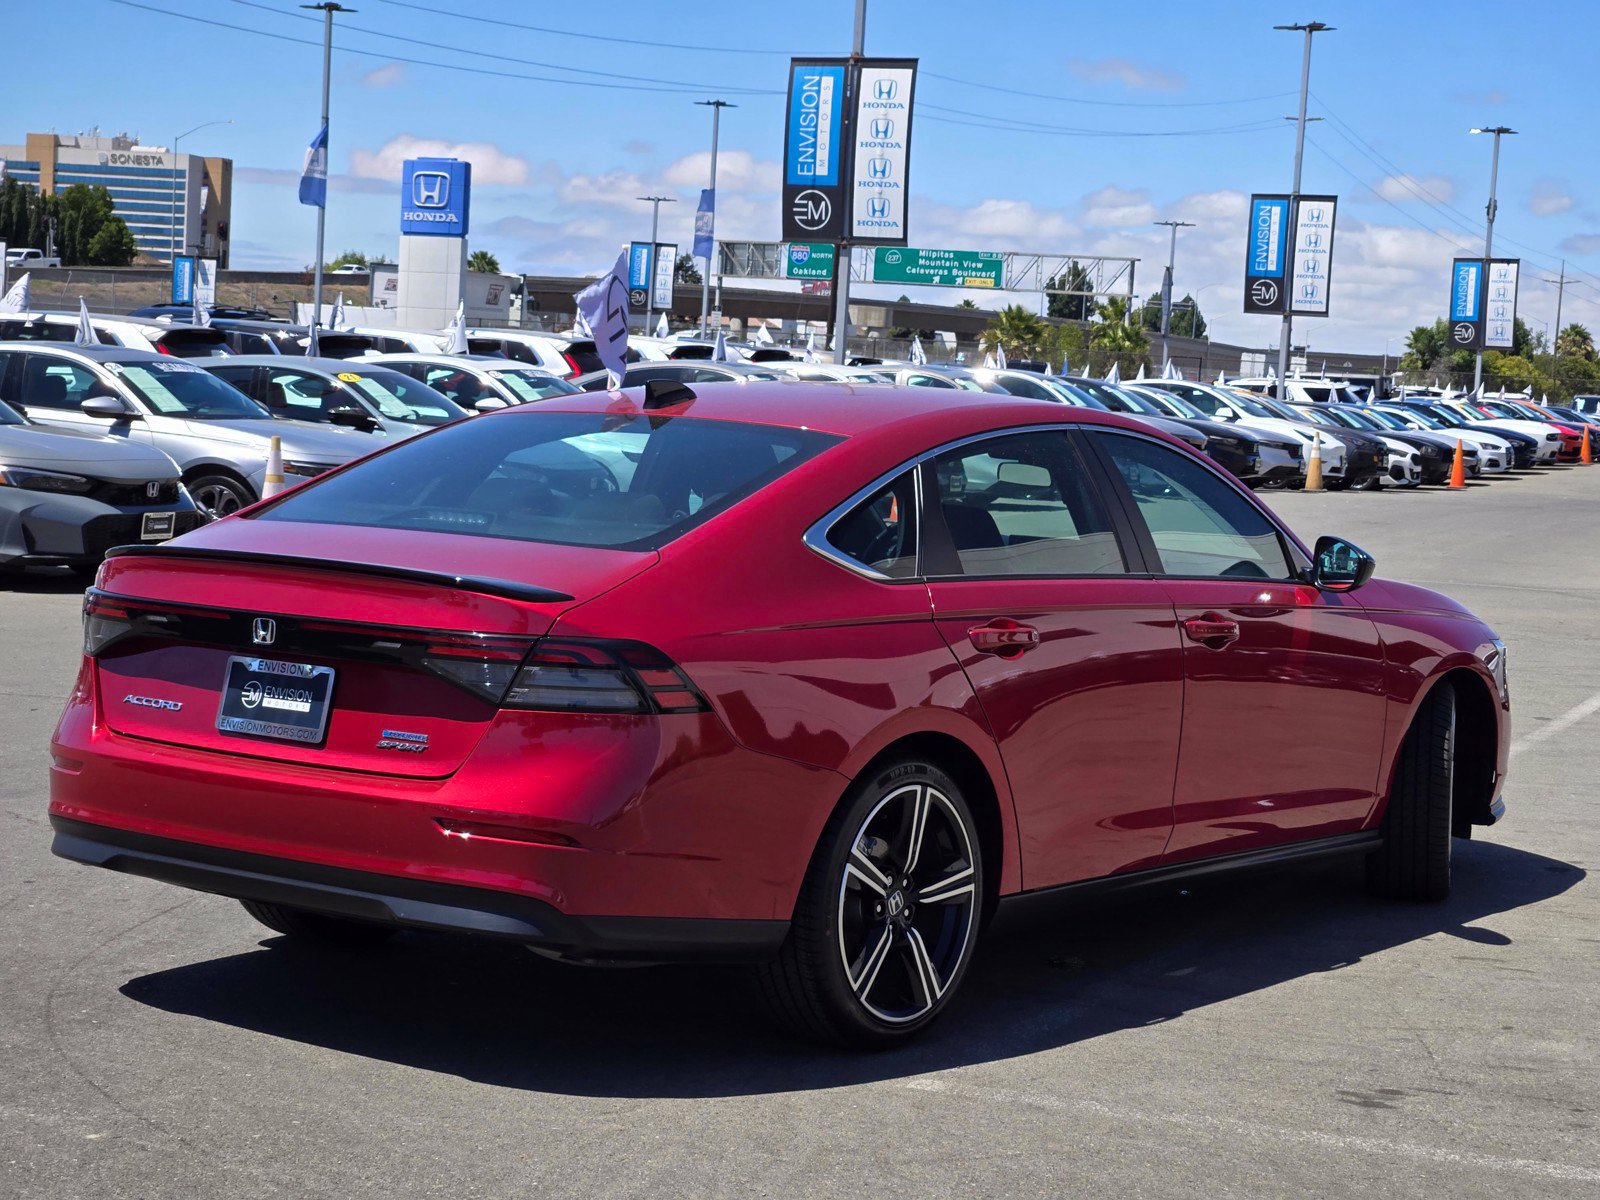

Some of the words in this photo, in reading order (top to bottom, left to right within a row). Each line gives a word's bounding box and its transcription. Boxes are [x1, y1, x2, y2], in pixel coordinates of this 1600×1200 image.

[797, 75, 820, 176] ENVISION
[819, 85, 831, 167] MOTORS
[860, 141, 902, 149] HONDA
[110, 153, 164, 167] SONESTA
[403, 211, 458, 223] HONDA
[1255, 205, 1272, 271] ENVISION
[792, 251, 808, 260] 880
[919, 250, 954, 259] Milpitas
[918, 259, 959, 267] Mountain
[963, 260, 984, 268] View
[792, 267, 827, 276] Oakland
[906, 266, 948, 275] Calaveras
[952, 269, 996, 278] Boulevard
[1456, 266, 1470, 317] ENVISION
[257, 660, 304, 676] ENVISION
[263, 685, 313, 703] ENVISION
[122, 694, 183, 711] ACCORD
[267, 700, 306, 709] MOTORS
[220, 718, 317, 740] ENVISIONMOTORS.COM
[378, 740, 428, 751] SPORT
